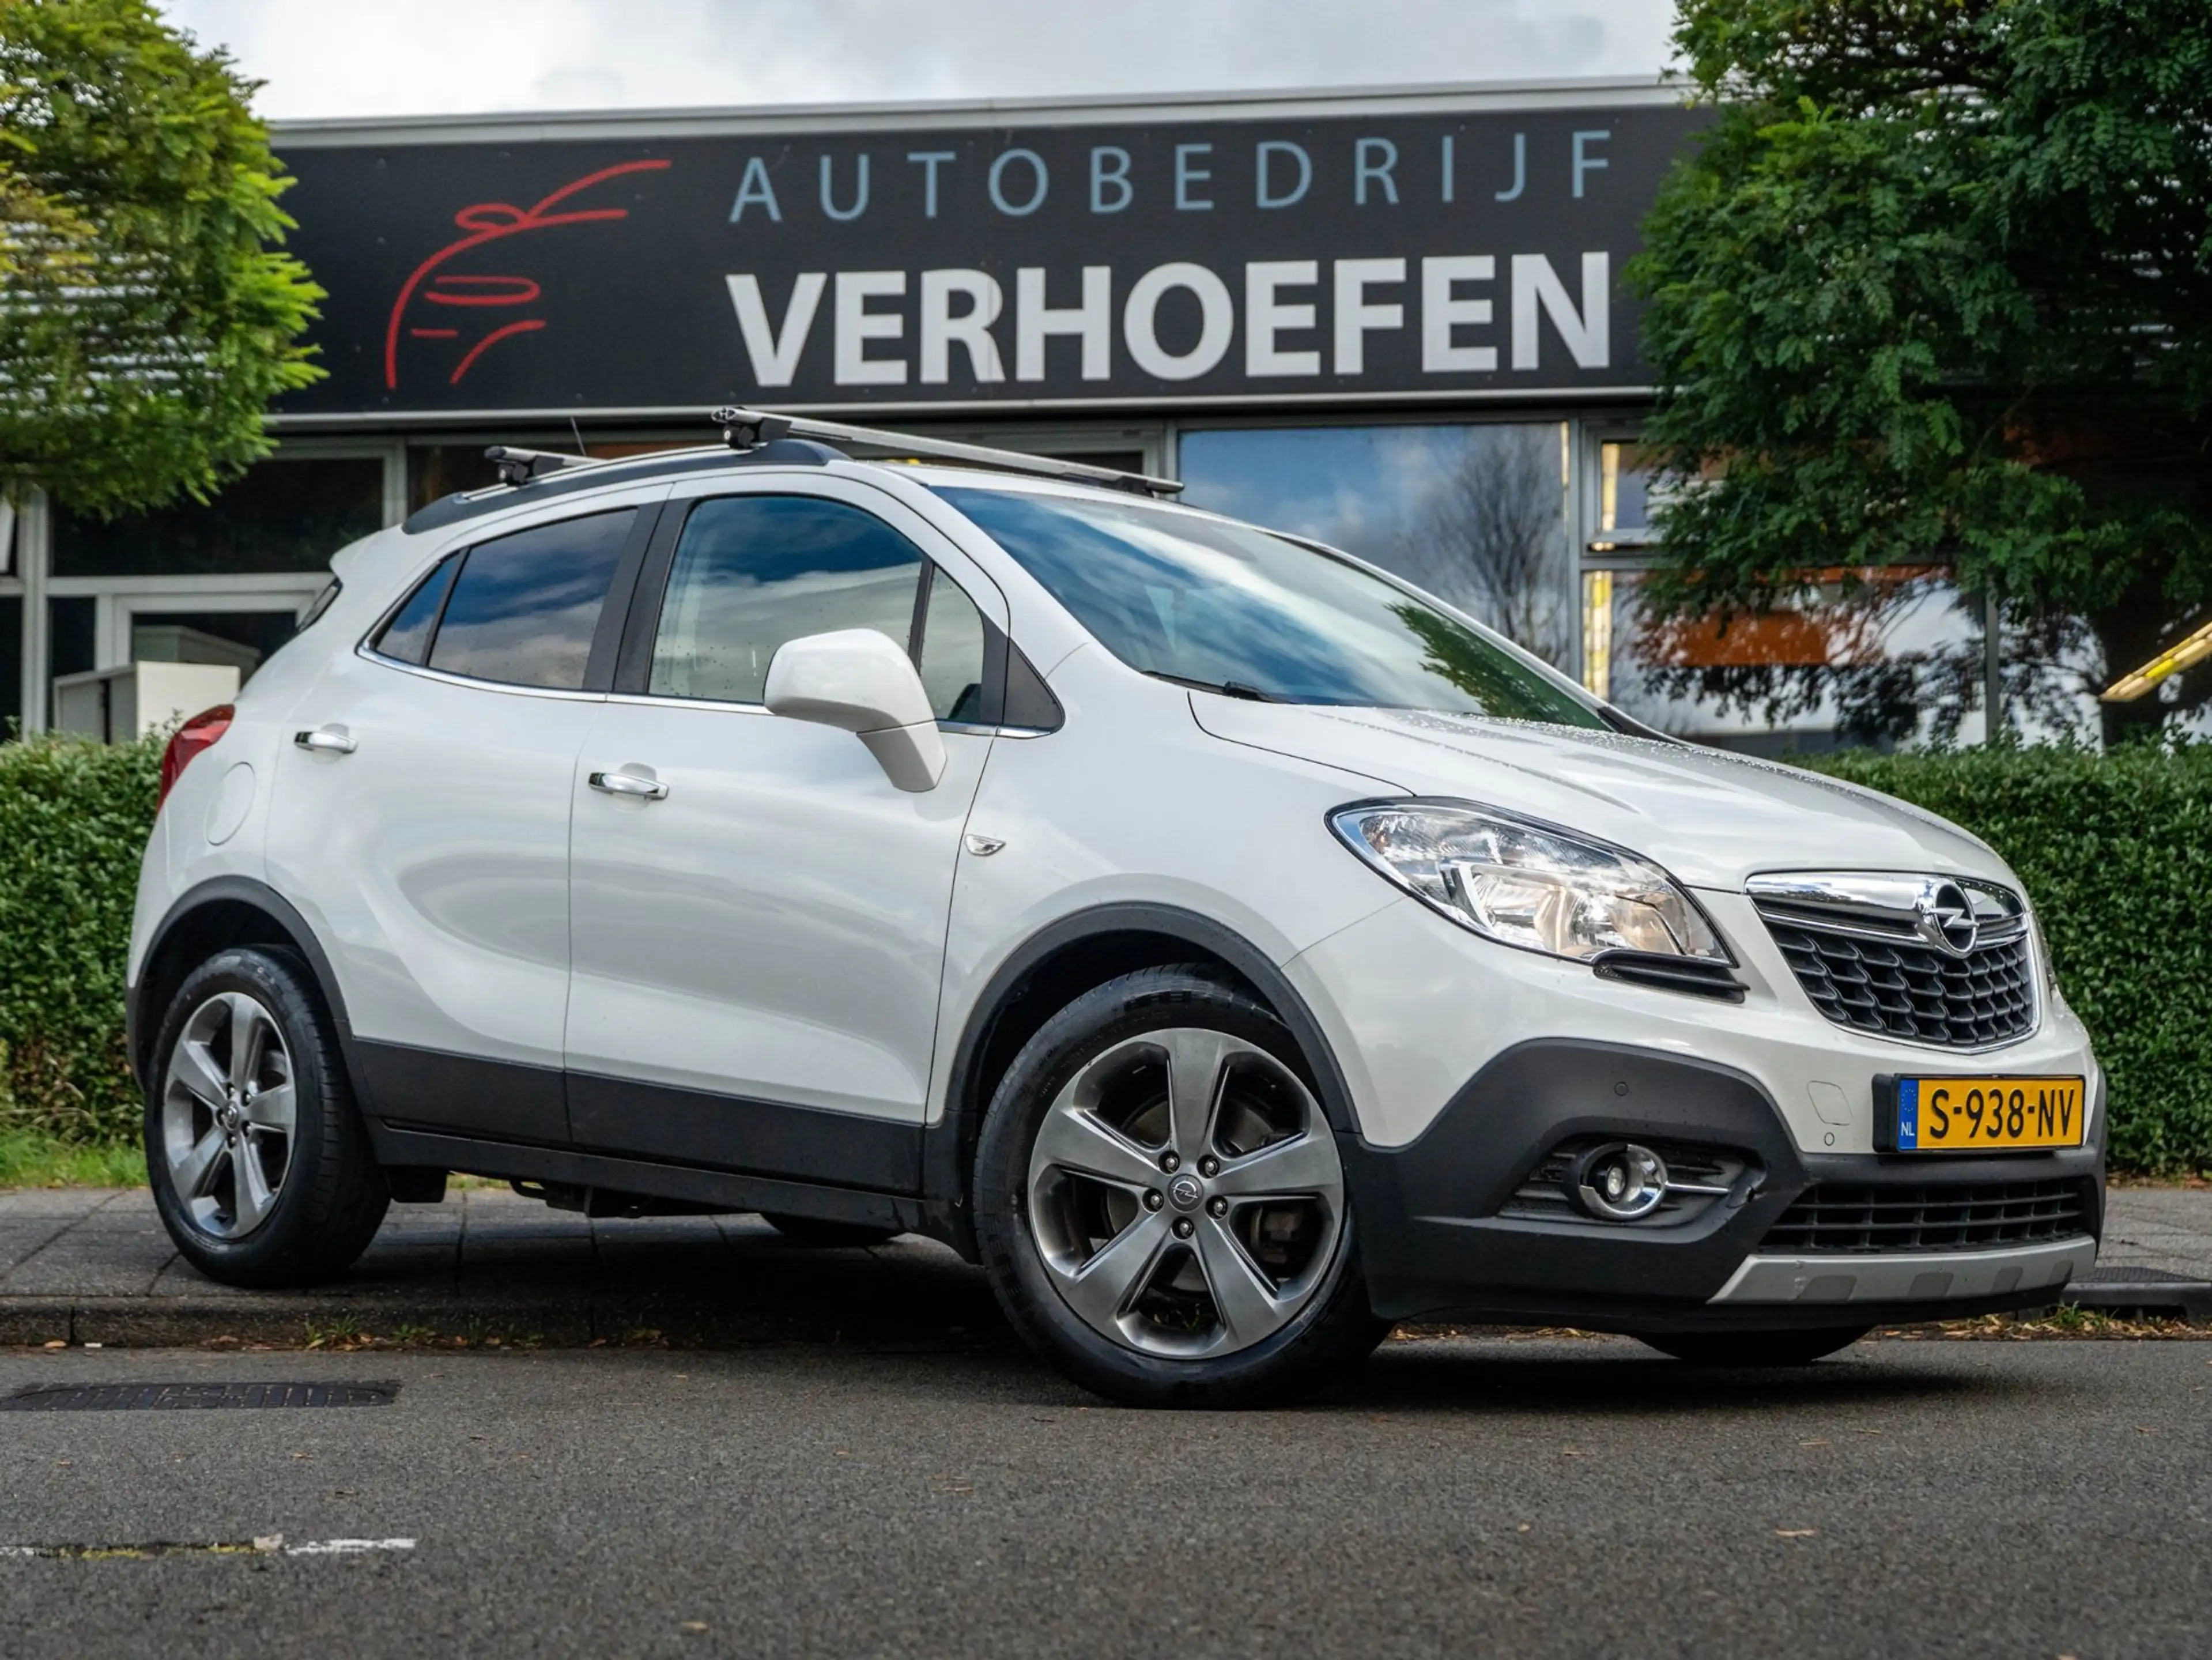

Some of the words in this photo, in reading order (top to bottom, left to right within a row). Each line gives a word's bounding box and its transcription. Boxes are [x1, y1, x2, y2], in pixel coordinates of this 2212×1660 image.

[729, 130, 1611, 222] AUTOBEDRIJF
[726, 251, 1610, 387] VERHOEFEN
[1900, 1122, 1915, 1137] NL
[1929, 1088, 2075, 1139] S-938-NV
